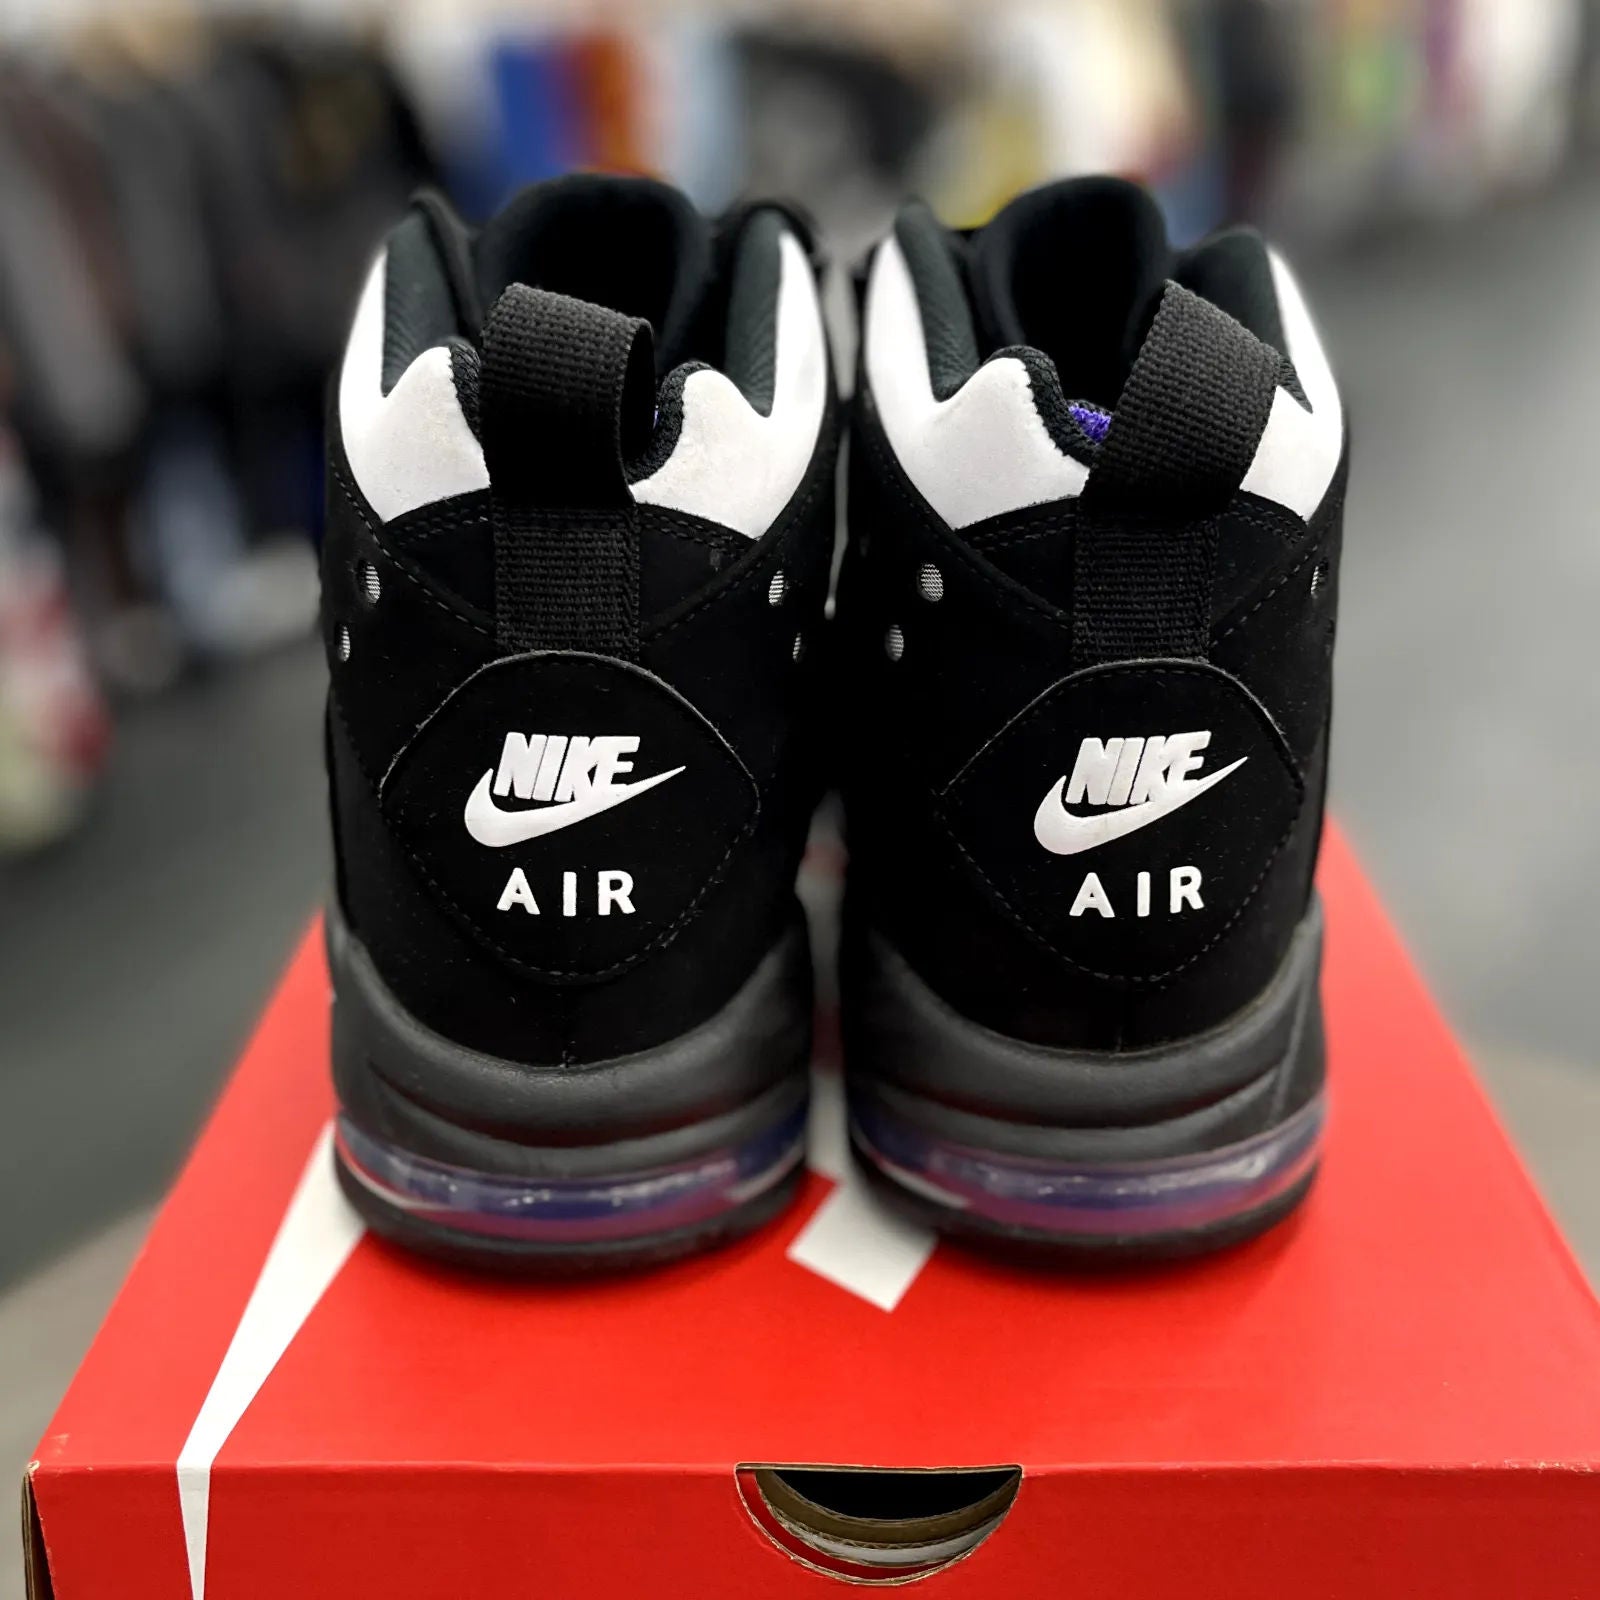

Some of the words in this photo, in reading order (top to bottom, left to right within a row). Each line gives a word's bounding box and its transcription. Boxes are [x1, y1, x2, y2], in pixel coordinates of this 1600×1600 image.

[493, 732, 641, 803] NIKE
[1065, 730, 1212, 806] NIKE
[496, 867, 636, 917] AIR
[1069, 865, 1205, 918] AIR
